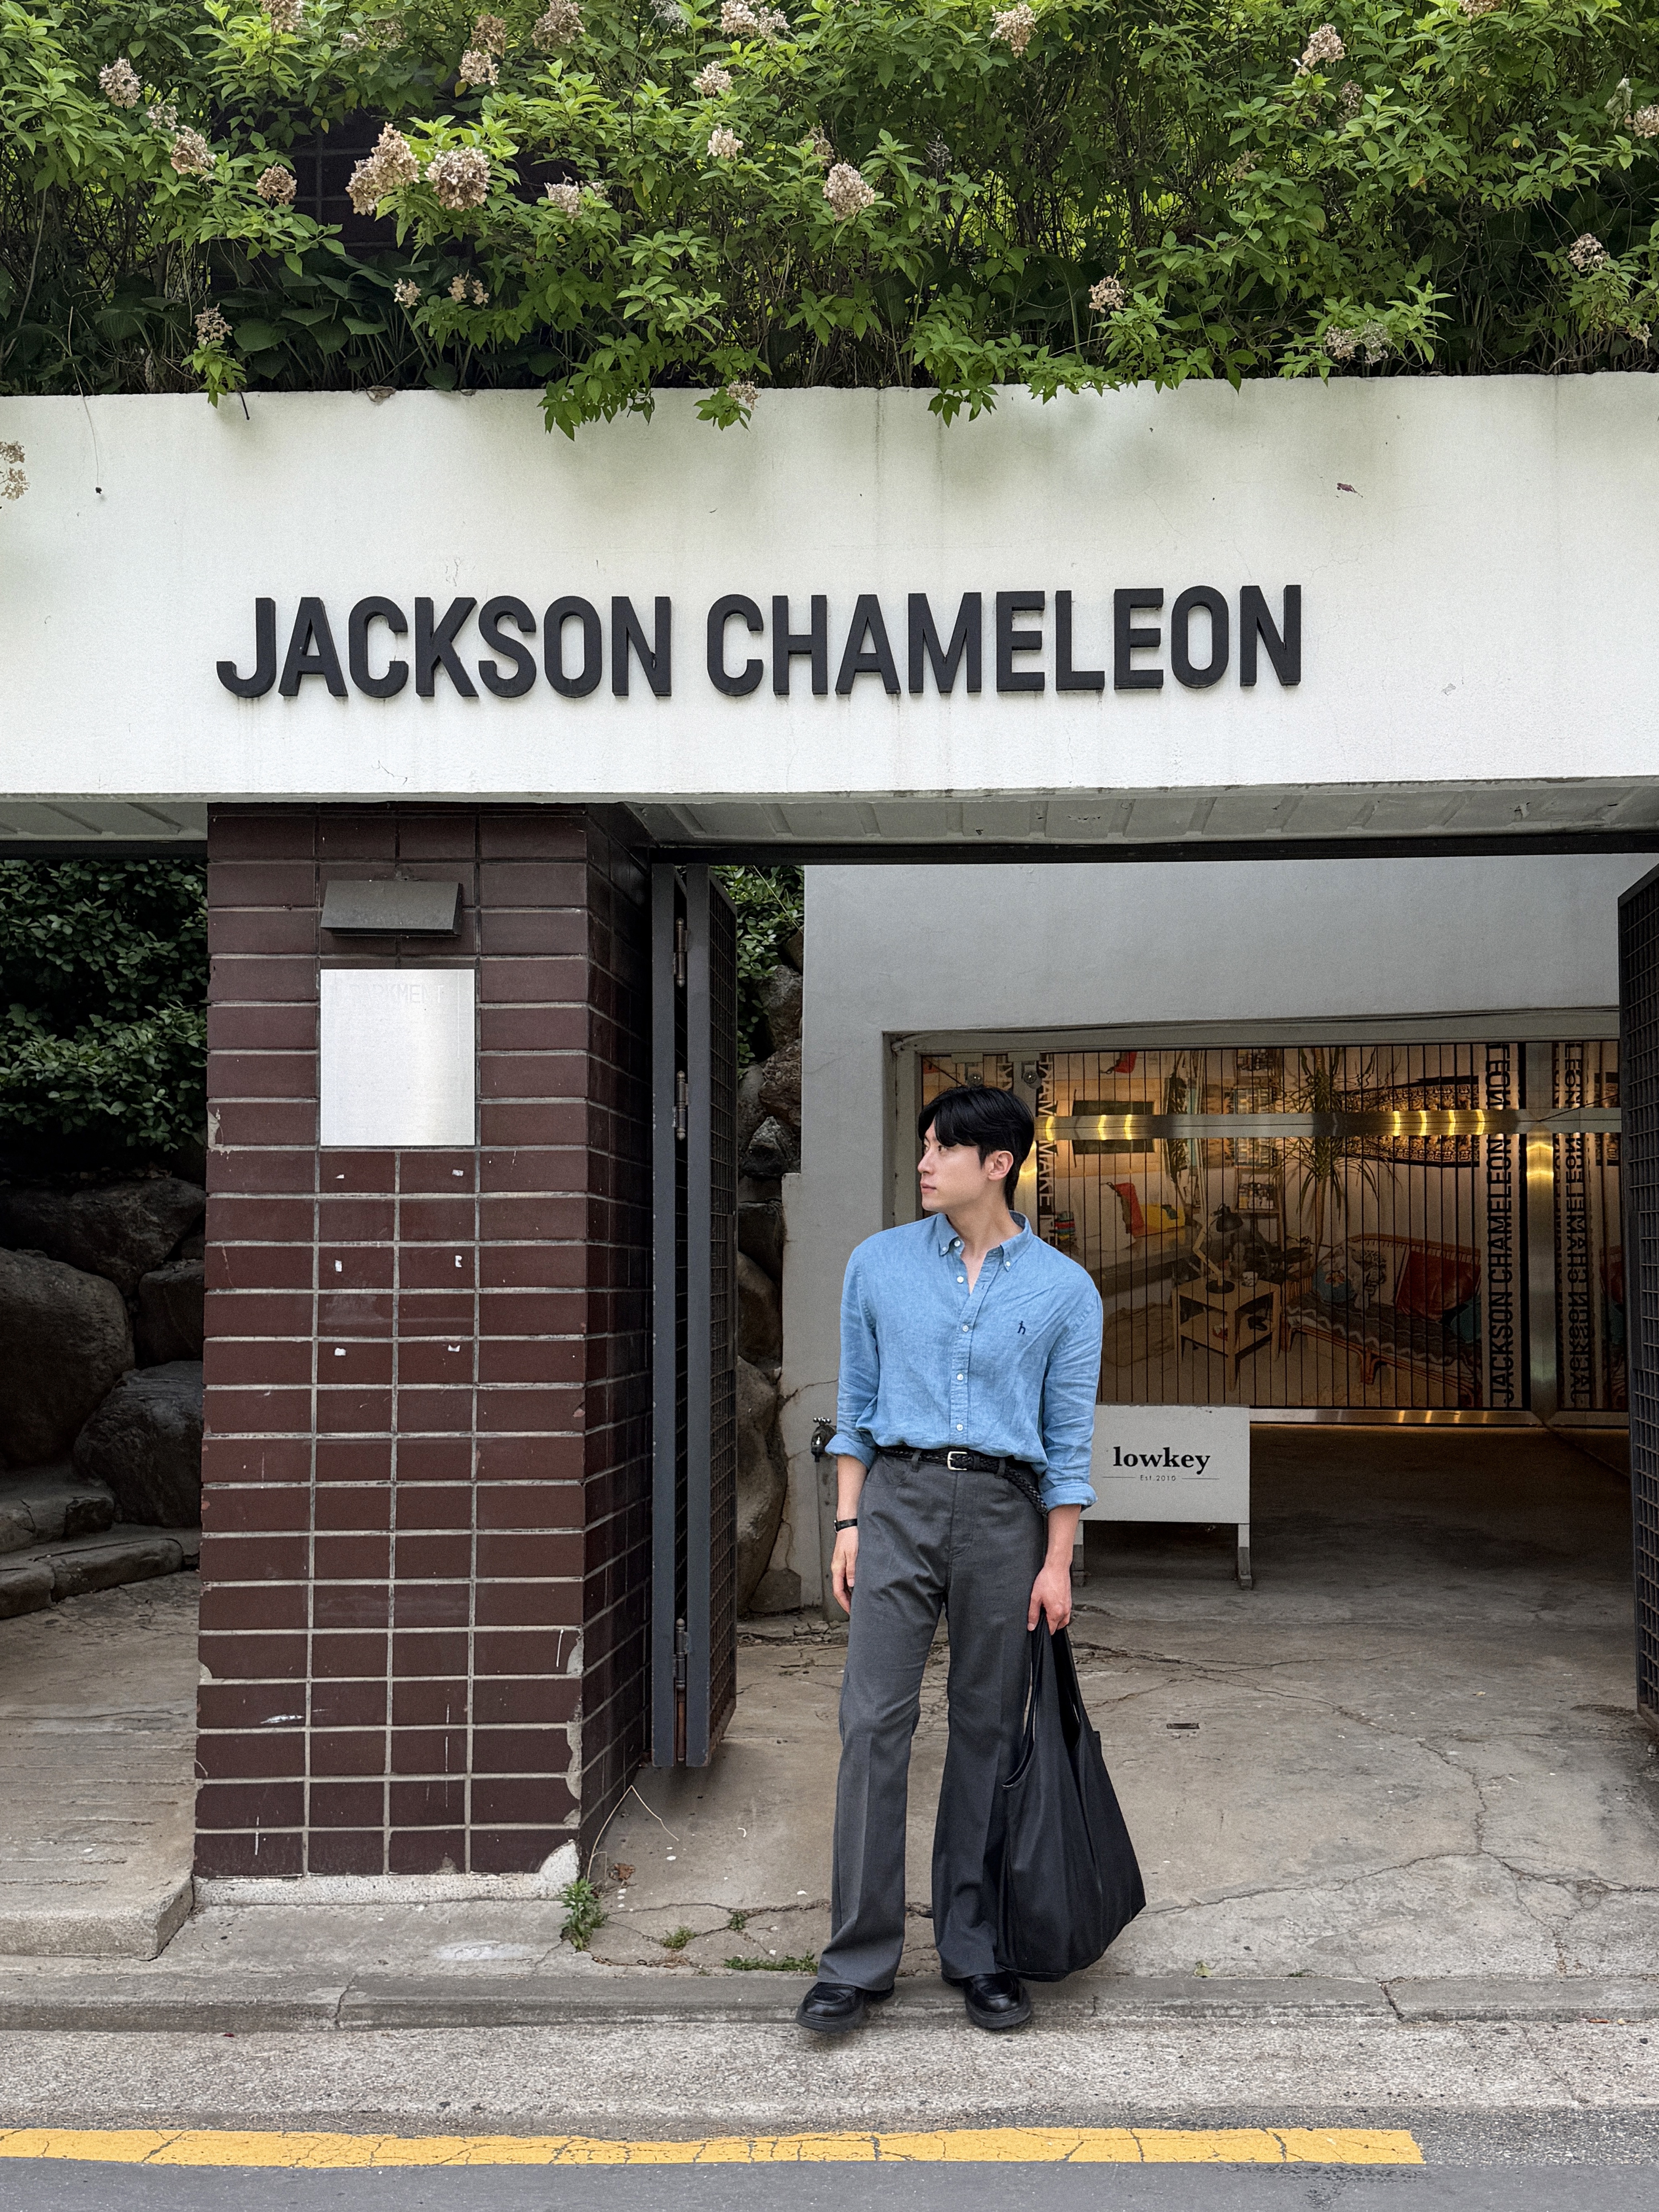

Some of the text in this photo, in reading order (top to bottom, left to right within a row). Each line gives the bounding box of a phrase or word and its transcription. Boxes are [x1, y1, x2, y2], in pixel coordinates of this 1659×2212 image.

[216, 584, 1302, 699] JACKSON CHAMELEON
[1487, 1138, 1514, 1402] JACKSON CHAMELEON
[1113, 1446, 1210, 1475] lowkey
